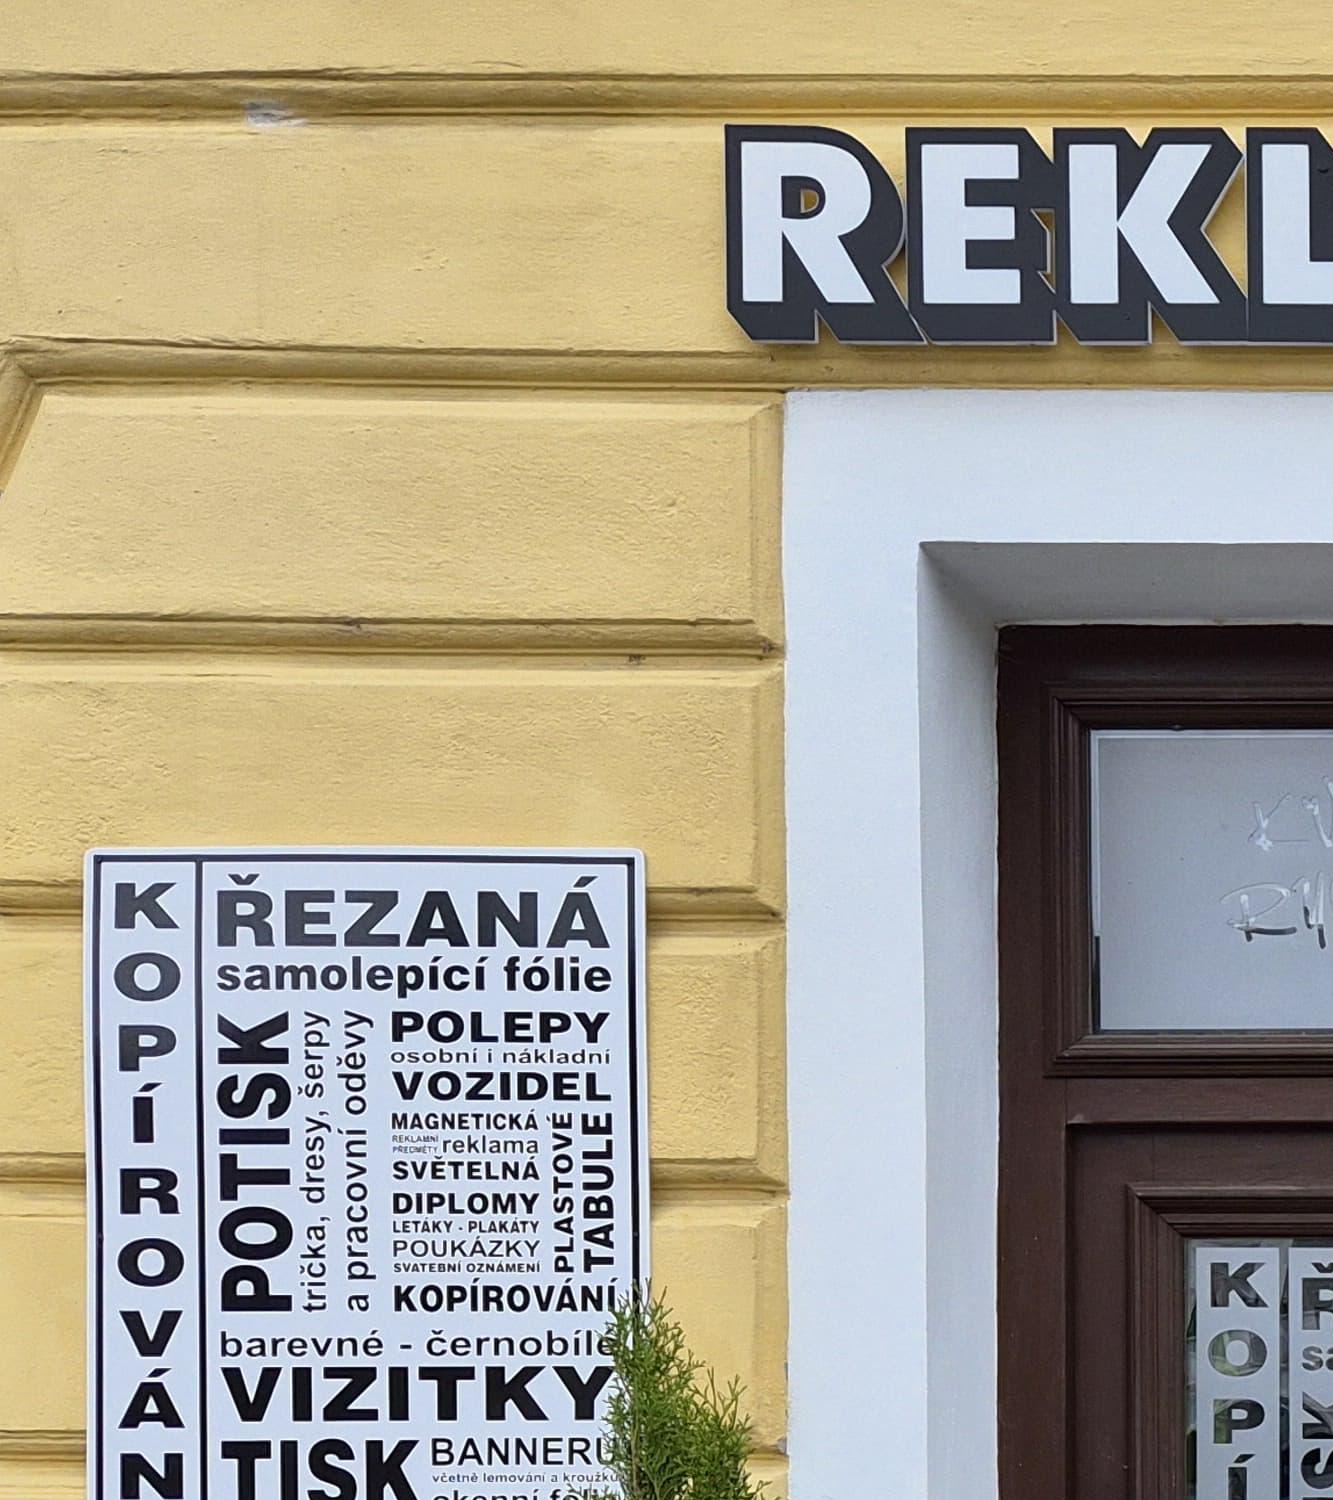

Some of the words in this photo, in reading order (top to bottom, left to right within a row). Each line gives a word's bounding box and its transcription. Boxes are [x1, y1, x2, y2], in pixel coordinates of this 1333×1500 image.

[216, 873, 611, 949] ŘEZANÁ
[216, 955, 489, 999] samolepící
[503, 955, 612, 993] fólie
[391, 1010, 611, 1044] POLEPY
[296, 1009, 332, 1100] šerpy
[336, 1009, 375, 1117] oděvy
[390, 1047, 478, 1064] osobní
[487, 1048, 493, 1064] i
[502, 1047, 610, 1065] nákladní
[391, 1070, 612, 1102] VOZIDEL
[391, 1108, 539, 1131] MAGNETICKÁ
[442, 1134, 539, 1154] reklama
[216, 1010, 294, 1313] POTISK
[392, 1155, 540, 1181] SVĚTELNÁ
[335, 1124, 380, 1284] pracovní
[392, 1192, 540, 1215] DIPLOMY
[545, 1112, 575, 1273] PLASTOVÉ
[580, 1112, 615, 1274] TABULE
[392, 1216, 453, 1234] LETÁKY
[468, 1216, 540, 1234] PLAKÁTY
[392, 1235, 541, 1258] POUKÁZKY
[393, 1261, 462, 1273] SVATEBNÍ
[465, 1261, 541, 1273] OZNÁMENÍ
[347, 1294, 370, 1312] a
[390, 1276, 617, 1315] KOPÍROVÁNÍ
[220, 1329, 384, 1358] barevné
[425, 1328, 616, 1358] černobílé
[220, 1366, 616, 1422] VIZITKY
